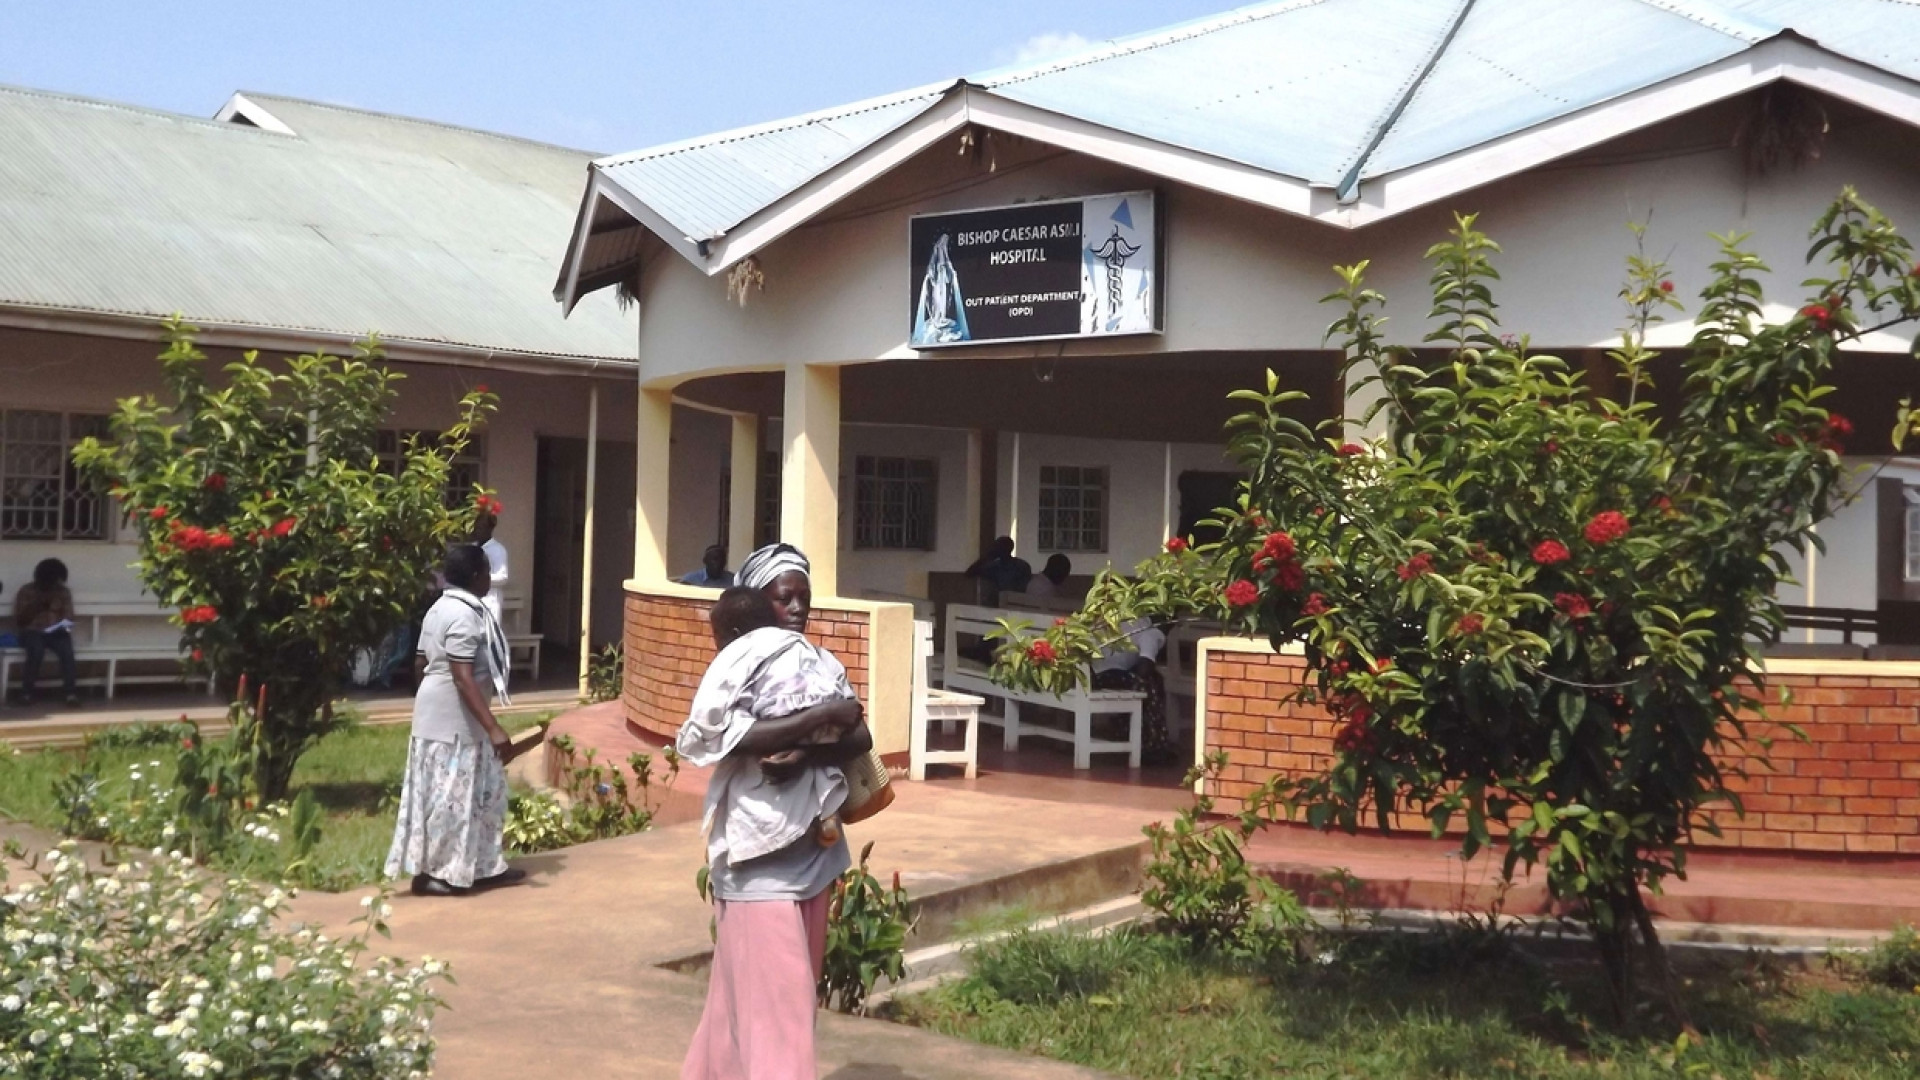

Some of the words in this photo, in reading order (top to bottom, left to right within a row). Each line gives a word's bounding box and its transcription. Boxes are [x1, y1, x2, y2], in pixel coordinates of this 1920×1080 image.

[958, 229, 1000, 246] BISHOP
[1002, 226, 1047, 242] CAESAR
[990, 248, 1046, 265] HOSPITAL
[965, 298, 984, 307] OUT
[985, 294, 1019, 305] PATIENT
[1020, 290, 1079, 303] DEPARTMENT
[1009, 307, 1034, 317] (OPD)
